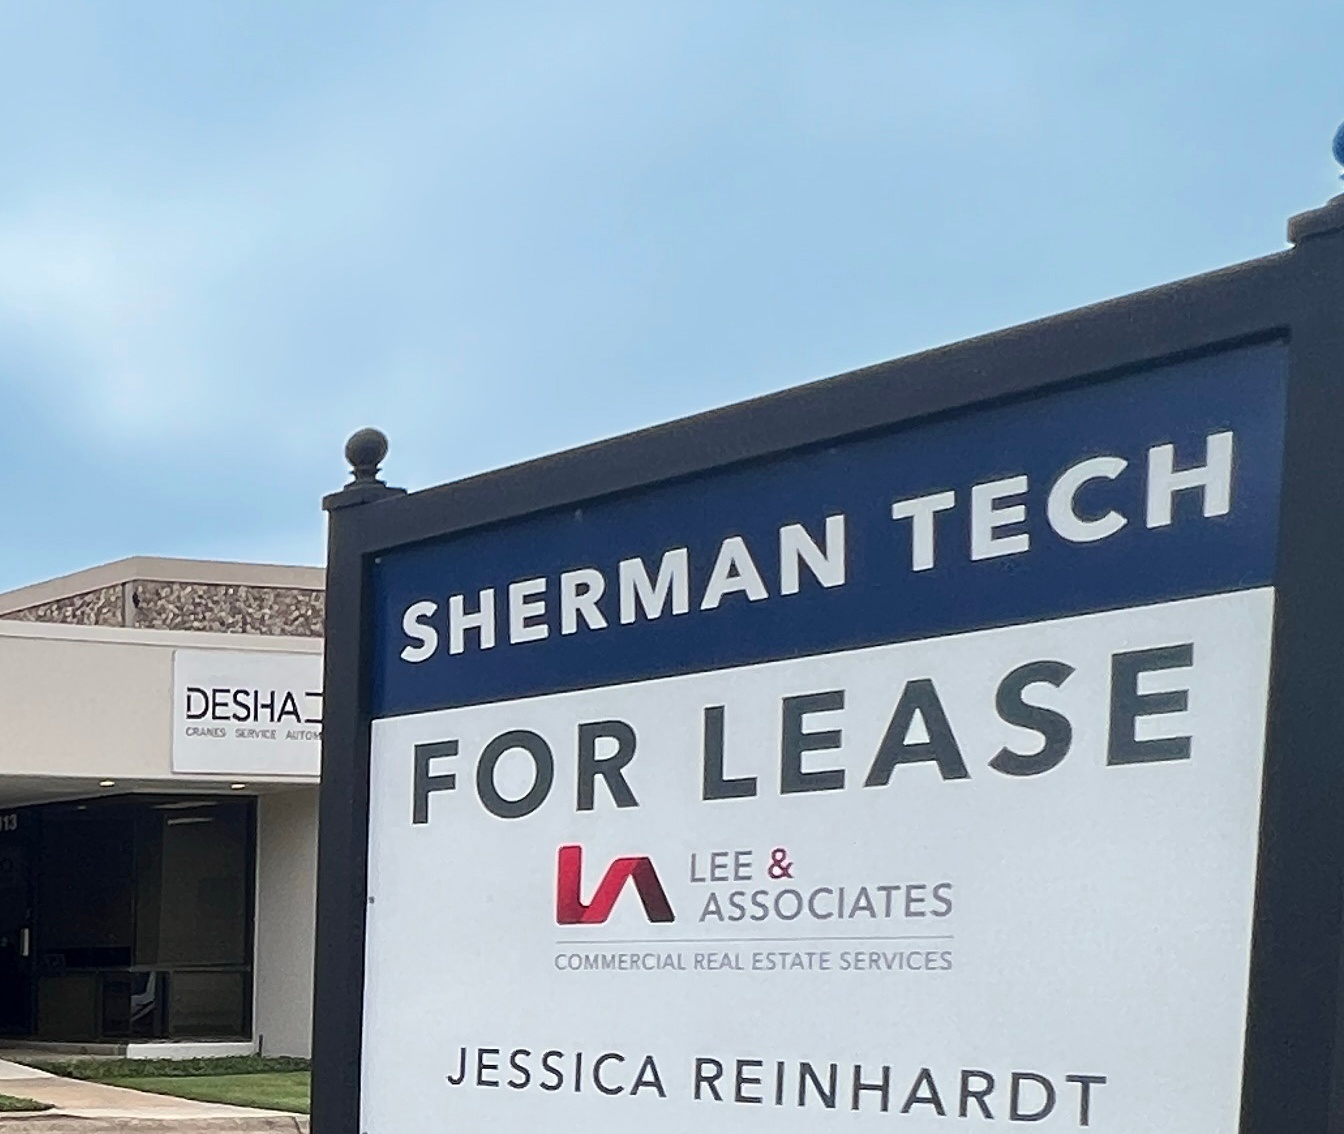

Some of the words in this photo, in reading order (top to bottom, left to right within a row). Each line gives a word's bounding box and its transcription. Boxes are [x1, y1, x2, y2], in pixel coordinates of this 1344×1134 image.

[399, 514, 845, 663] SHERMAN
[892, 431, 1234, 572] TECH
[185, 726, 227, 738] CRANES
[234, 728, 277, 741] SERVICE
[411, 719, 641, 826] FOR
[702, 642, 1195, 802] LEASE
[689, 850, 753, 883] LEE
[767, 847, 794, 880] &
[698, 882, 954, 923] ASSOCIATES
[554, 951, 686, 972] COMMERCIAL
[693, 952, 745, 971] REAL
[751, 951, 832, 971] ESTATE
[839, 950, 953, 972] SERVICES
[446, 1046, 668, 1099] JESSICA
[693, 1056, 1109, 1128] REINHARDT
